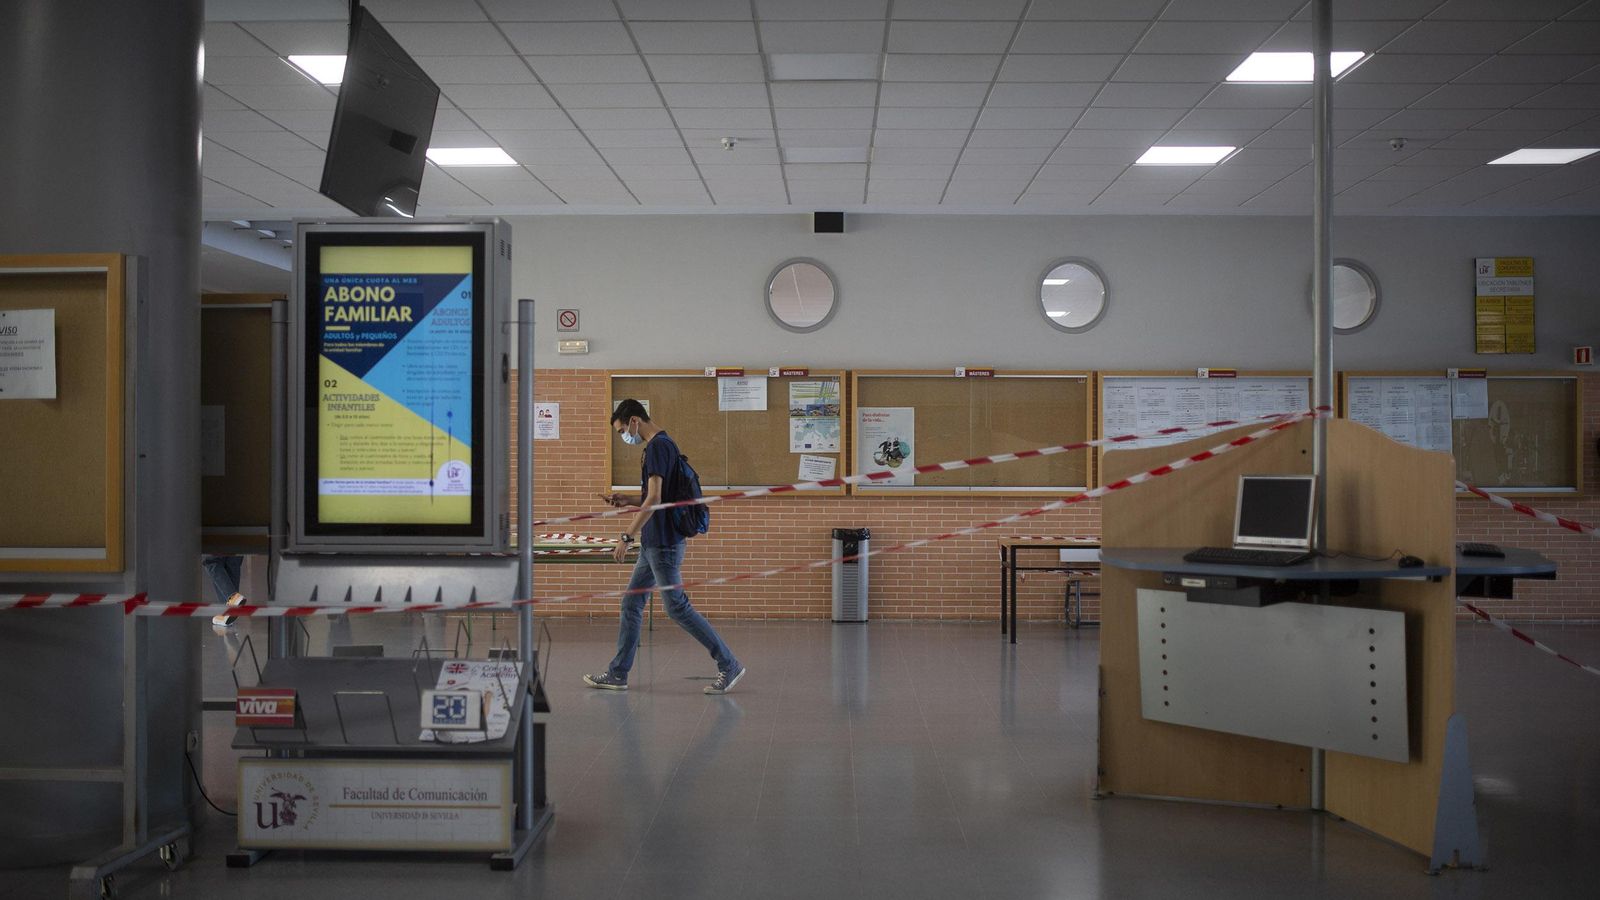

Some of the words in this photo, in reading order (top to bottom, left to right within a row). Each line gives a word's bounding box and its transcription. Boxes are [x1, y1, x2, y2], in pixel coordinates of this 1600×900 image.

[324, 286, 396, 302] ABONO
[324, 306, 413, 322] FAMILIAR
[361, 331, 398, 340] PEQUEÑOS
[324, 380, 337, 388] 02
[323, 393, 381, 402] ACTIVIDADES
[328, 403, 376, 411] INFANTILES
[239, 698, 277, 714] viva
[434, 696, 465, 718] 20
[254, 771, 304, 801] UNIVERSIDAD
[343, 787, 389, 801] Facultad
[392, 787, 406, 801] de
[408, 787, 488, 801] Comunicación
[370, 811, 420, 820] UNIVERSIDAD
[430, 811, 460, 820] SEVILLA
